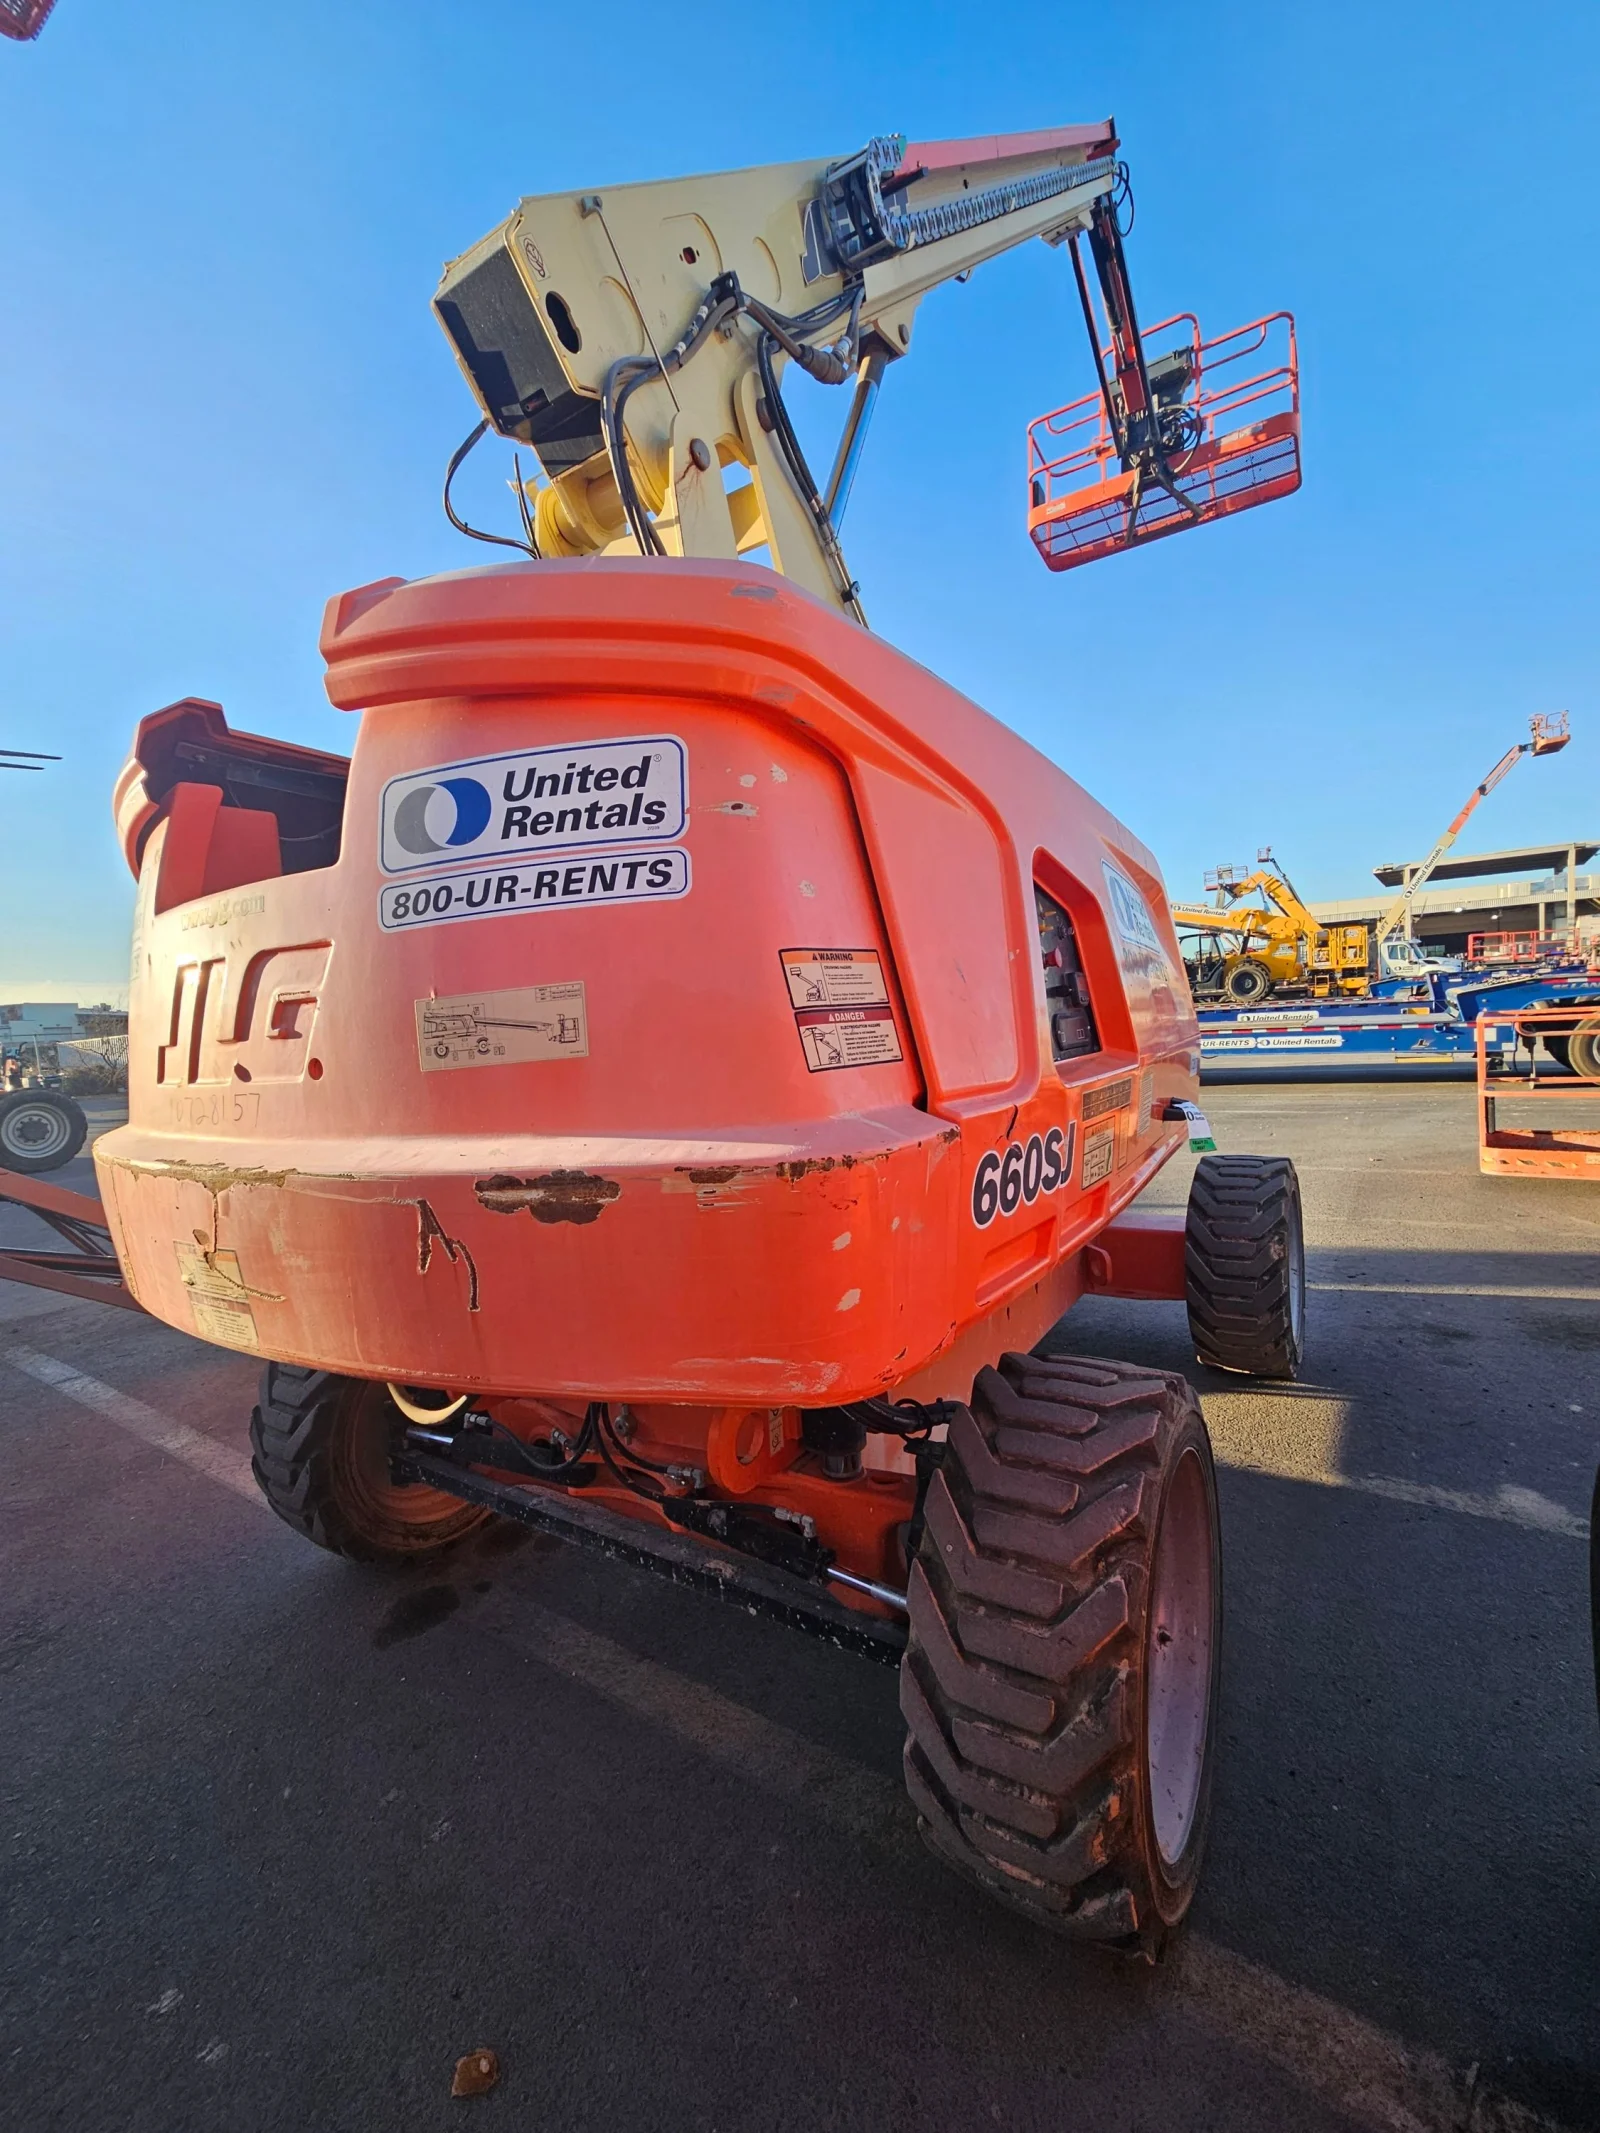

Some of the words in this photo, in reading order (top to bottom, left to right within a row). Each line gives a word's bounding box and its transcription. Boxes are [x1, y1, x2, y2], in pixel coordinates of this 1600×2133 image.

[502, 755, 652, 802] United
[501, 793, 667, 840] Rentals
[1410, 870, 1427, 891] United
[1425, 848, 1442, 870] Rentals
[391, 858, 673, 920] 800-UR-RENTS
[1182, 906, 1203, 914] United
[1203, 909, 1227, 917] Rentals
[818, 952, 854, 961] WARNING
[834, 1011, 866, 1021] DANGER
[1281, 1013, 1314, 1021] Rentals
[1272, 1038, 1302, 1046] United
[1303, 1037, 1337, 1045] Rentals
[972, 1121, 1077, 1227] 660SJ
